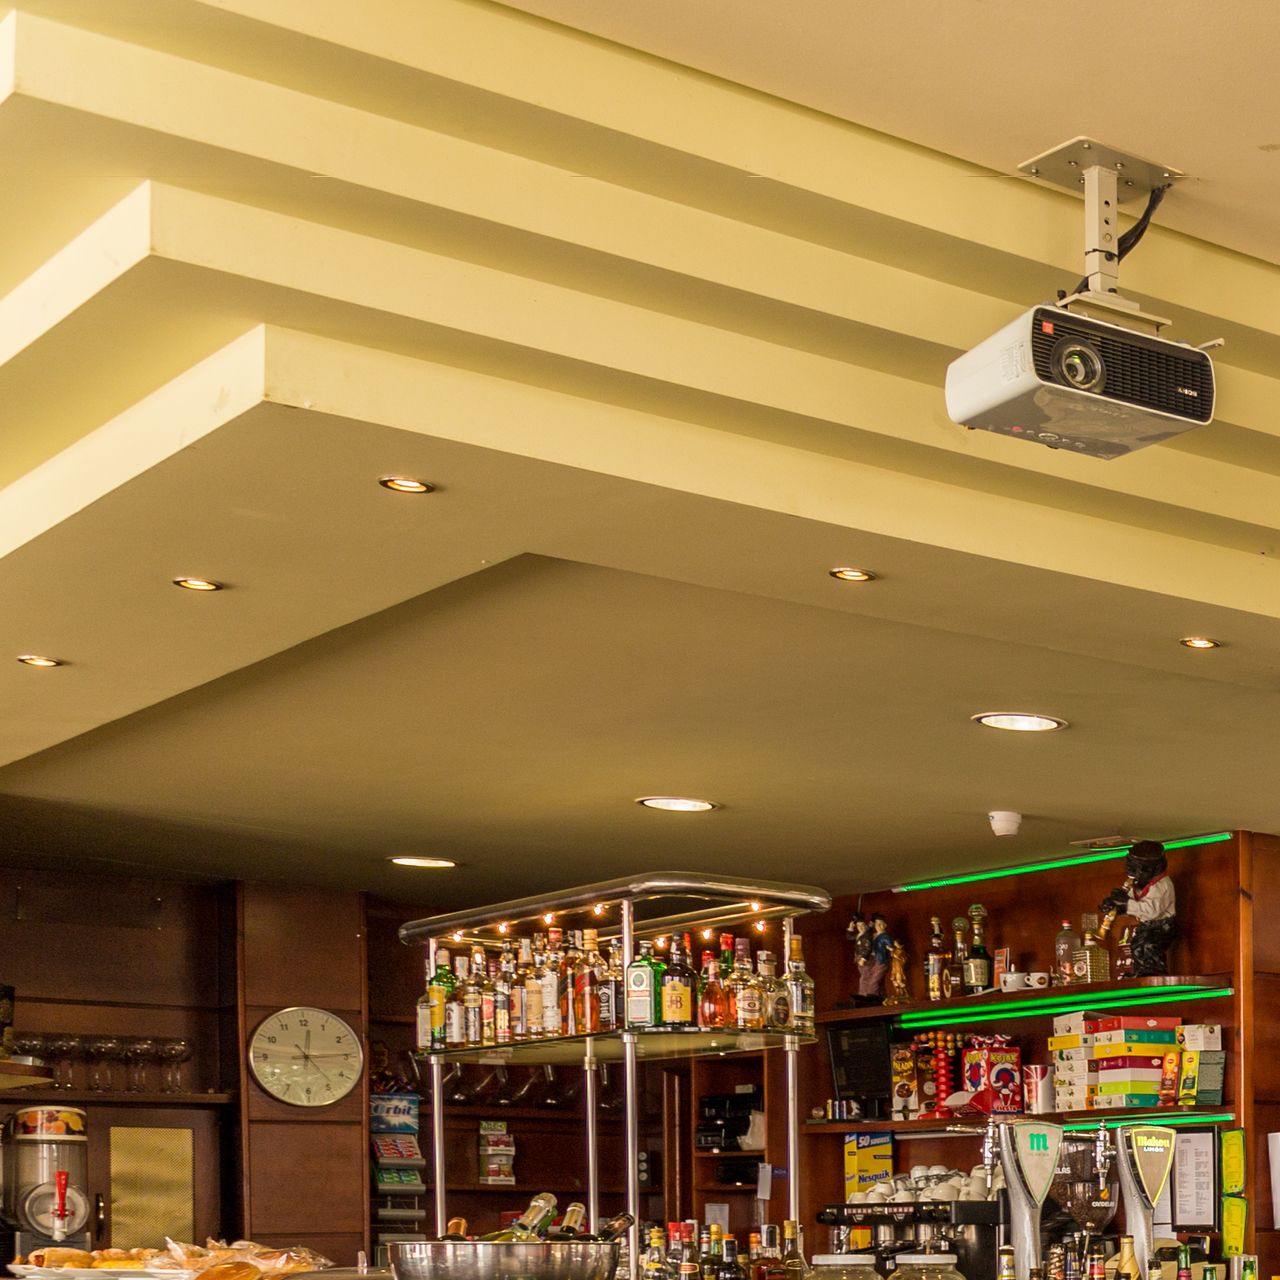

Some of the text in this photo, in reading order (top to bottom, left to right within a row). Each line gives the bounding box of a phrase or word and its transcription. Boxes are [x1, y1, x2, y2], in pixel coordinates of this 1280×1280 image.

[373, 1104, 412, 1116] Orbit
[1136, 1135, 1170, 1148] Mahou
[858, 1168, 890, 1184] Nesquik
